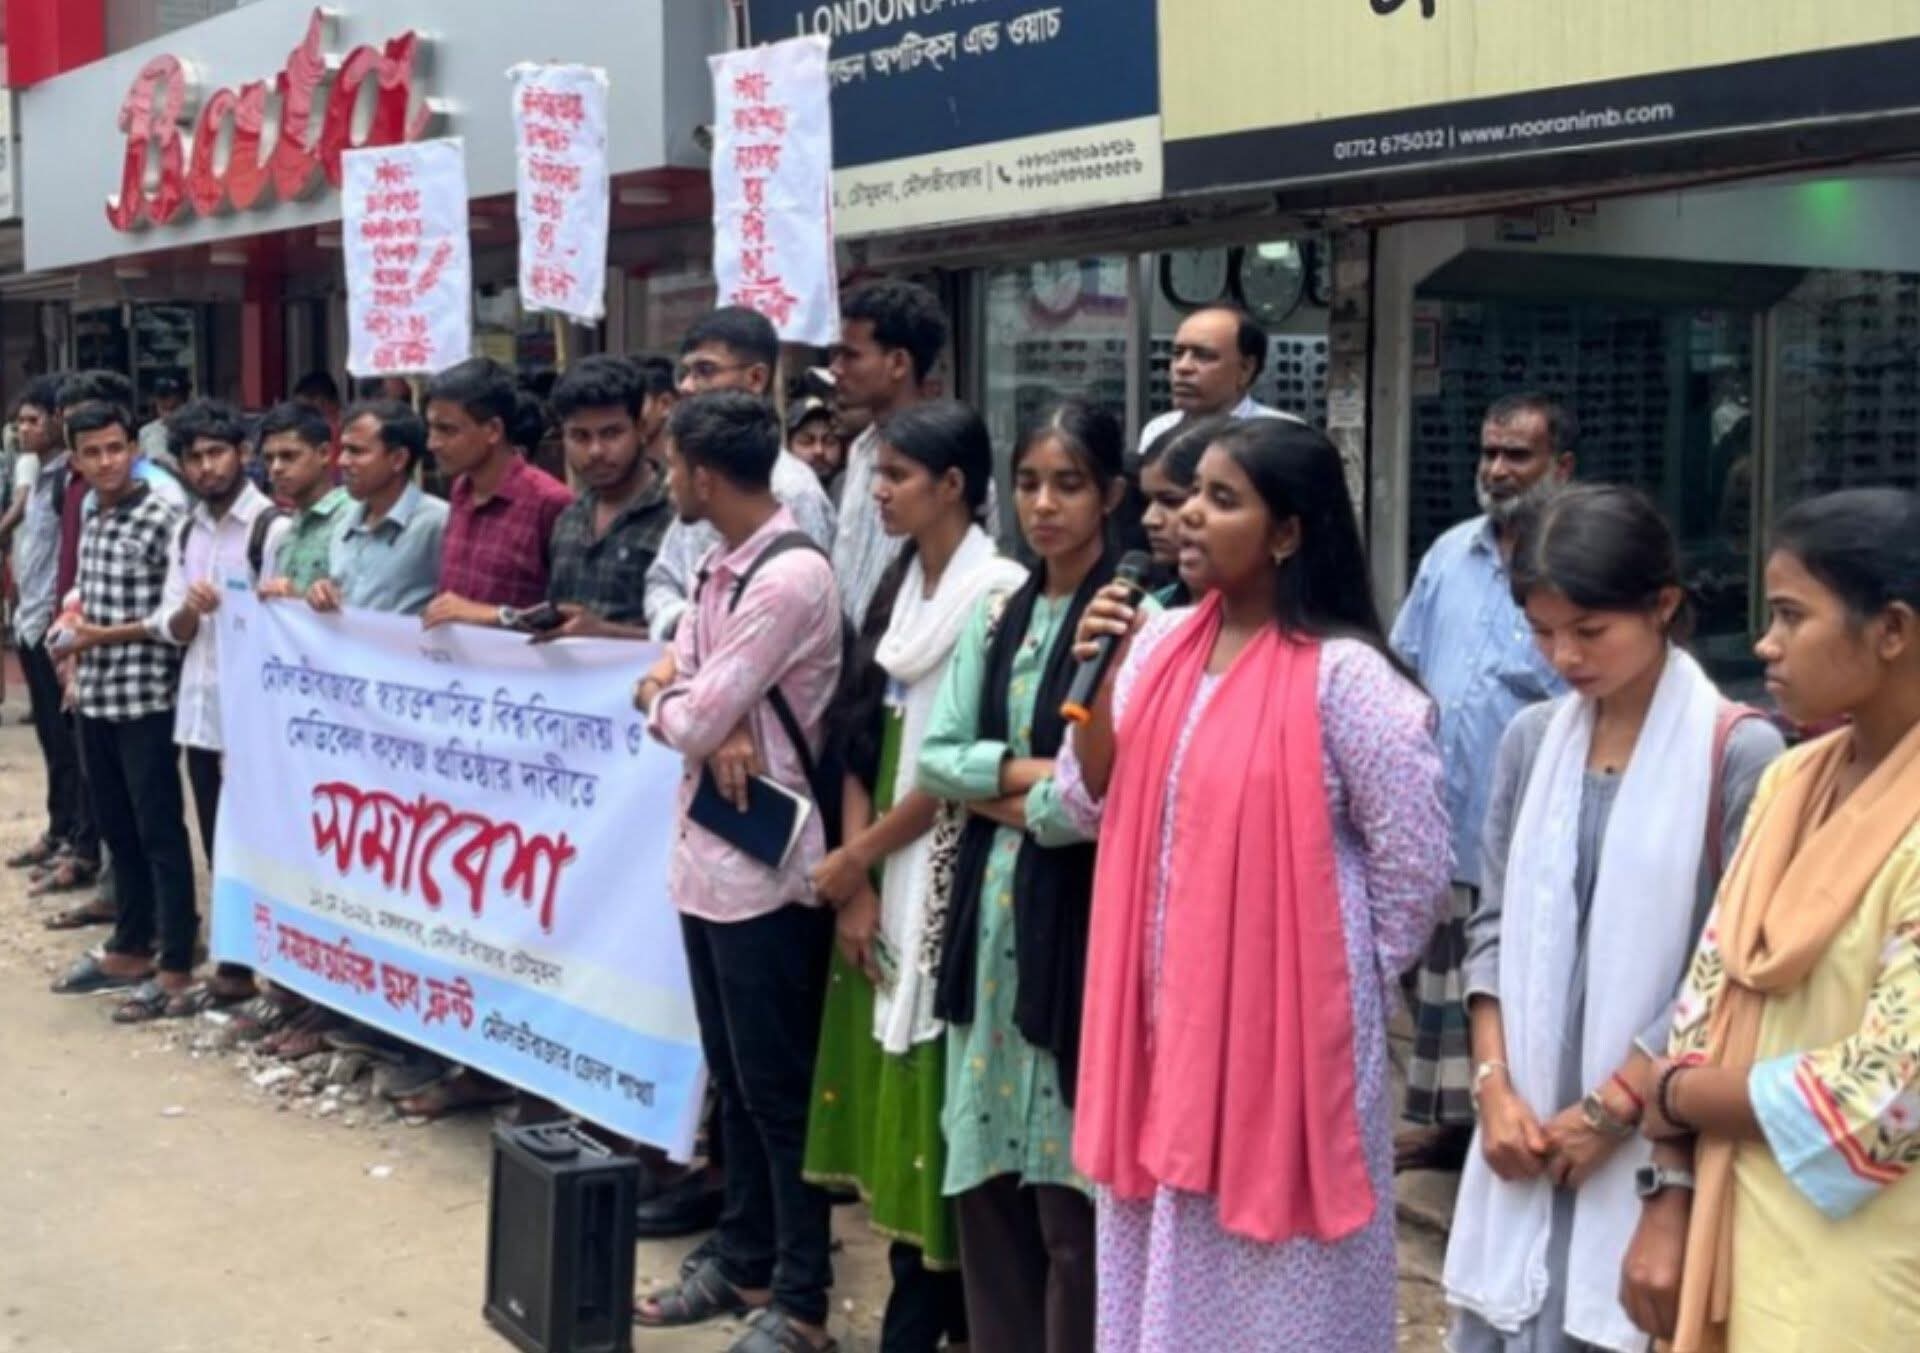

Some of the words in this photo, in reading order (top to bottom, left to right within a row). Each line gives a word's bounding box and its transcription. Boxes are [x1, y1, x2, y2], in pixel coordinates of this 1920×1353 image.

[796, 0, 916, 38] LONDON
[1006, 8, 1063, 45] ওয়াচ
[105, 6, 430, 232] Bata
[1333, 138, 1376, 160] 01712
[1380, 130, 1444, 155] 675032
[1459, 102, 1674, 146] www.nooranimb.com
[627, 722, 643, 757] ও
[311, 780, 579, 936] সমাবেশ
[481, 1009, 573, 1073] মৌলভীবাজার
[574, 1052, 614, 1091] জেলা
